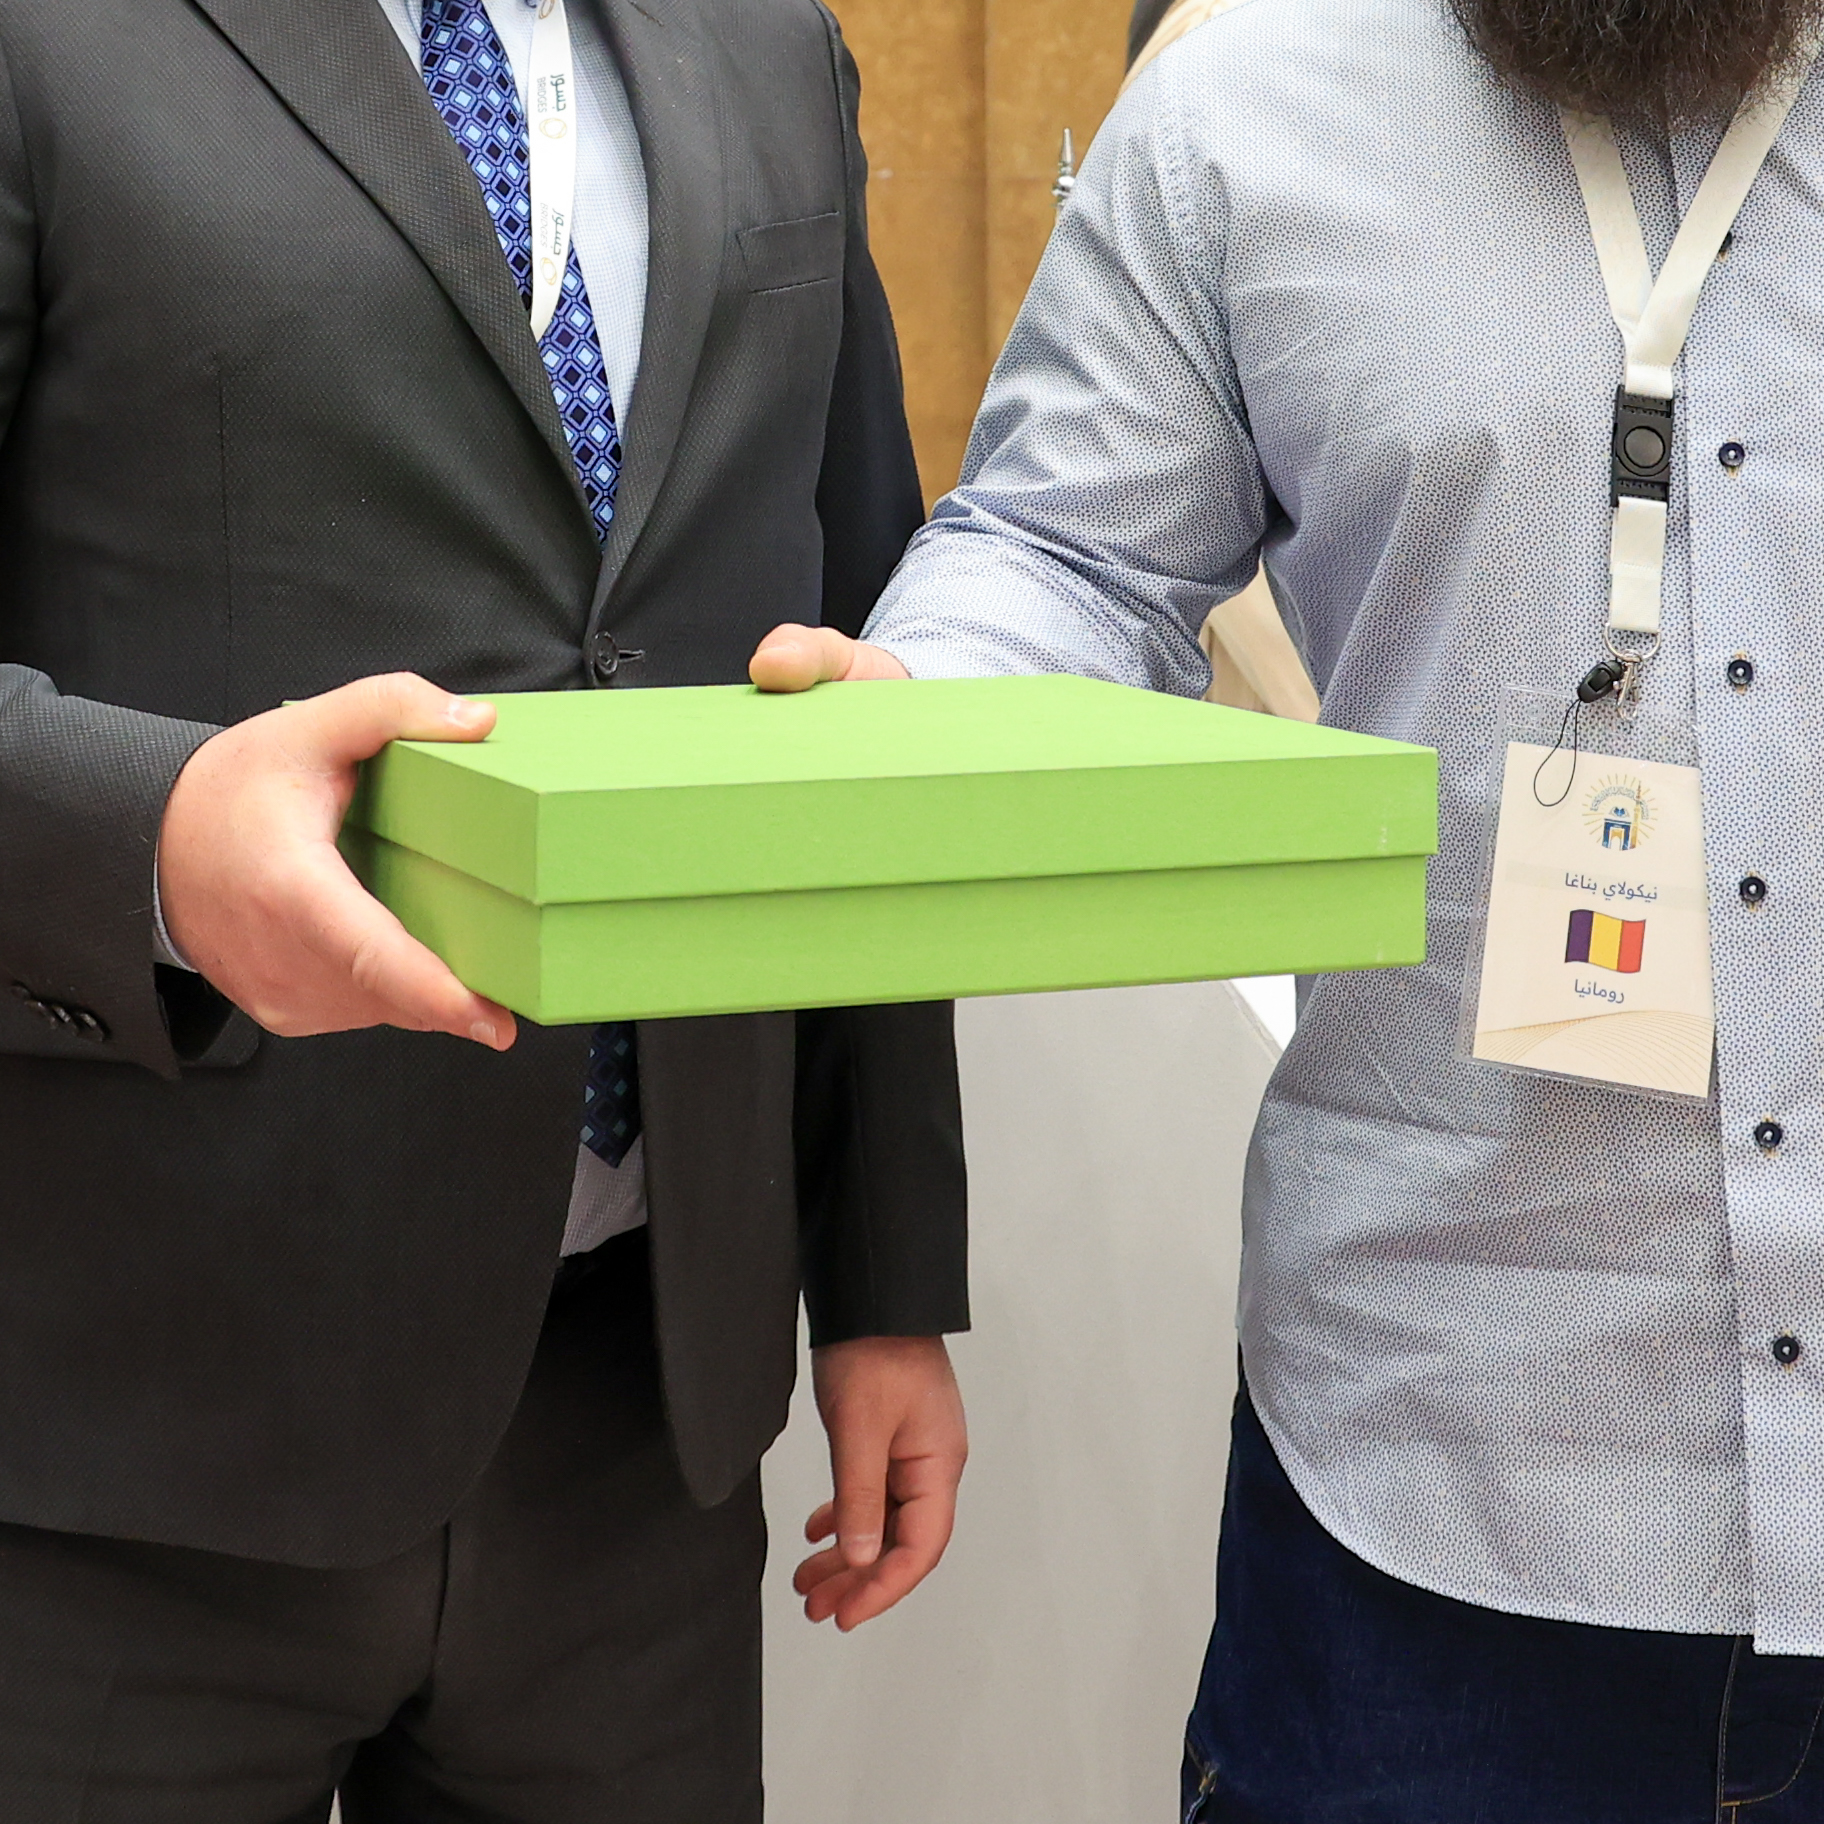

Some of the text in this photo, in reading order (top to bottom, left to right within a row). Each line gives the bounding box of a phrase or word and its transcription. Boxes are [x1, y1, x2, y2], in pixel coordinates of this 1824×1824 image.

[536, 76, 548, 113] BRIDGES
[550, 73, 567, 112] جسور
[539, 202, 549, 249] BRIDGES
[550, 207, 565, 256] جسور
[1565, 872, 1658, 903] نيكولاي بناغا
[1574, 978, 1625, 1004] رومانيا
